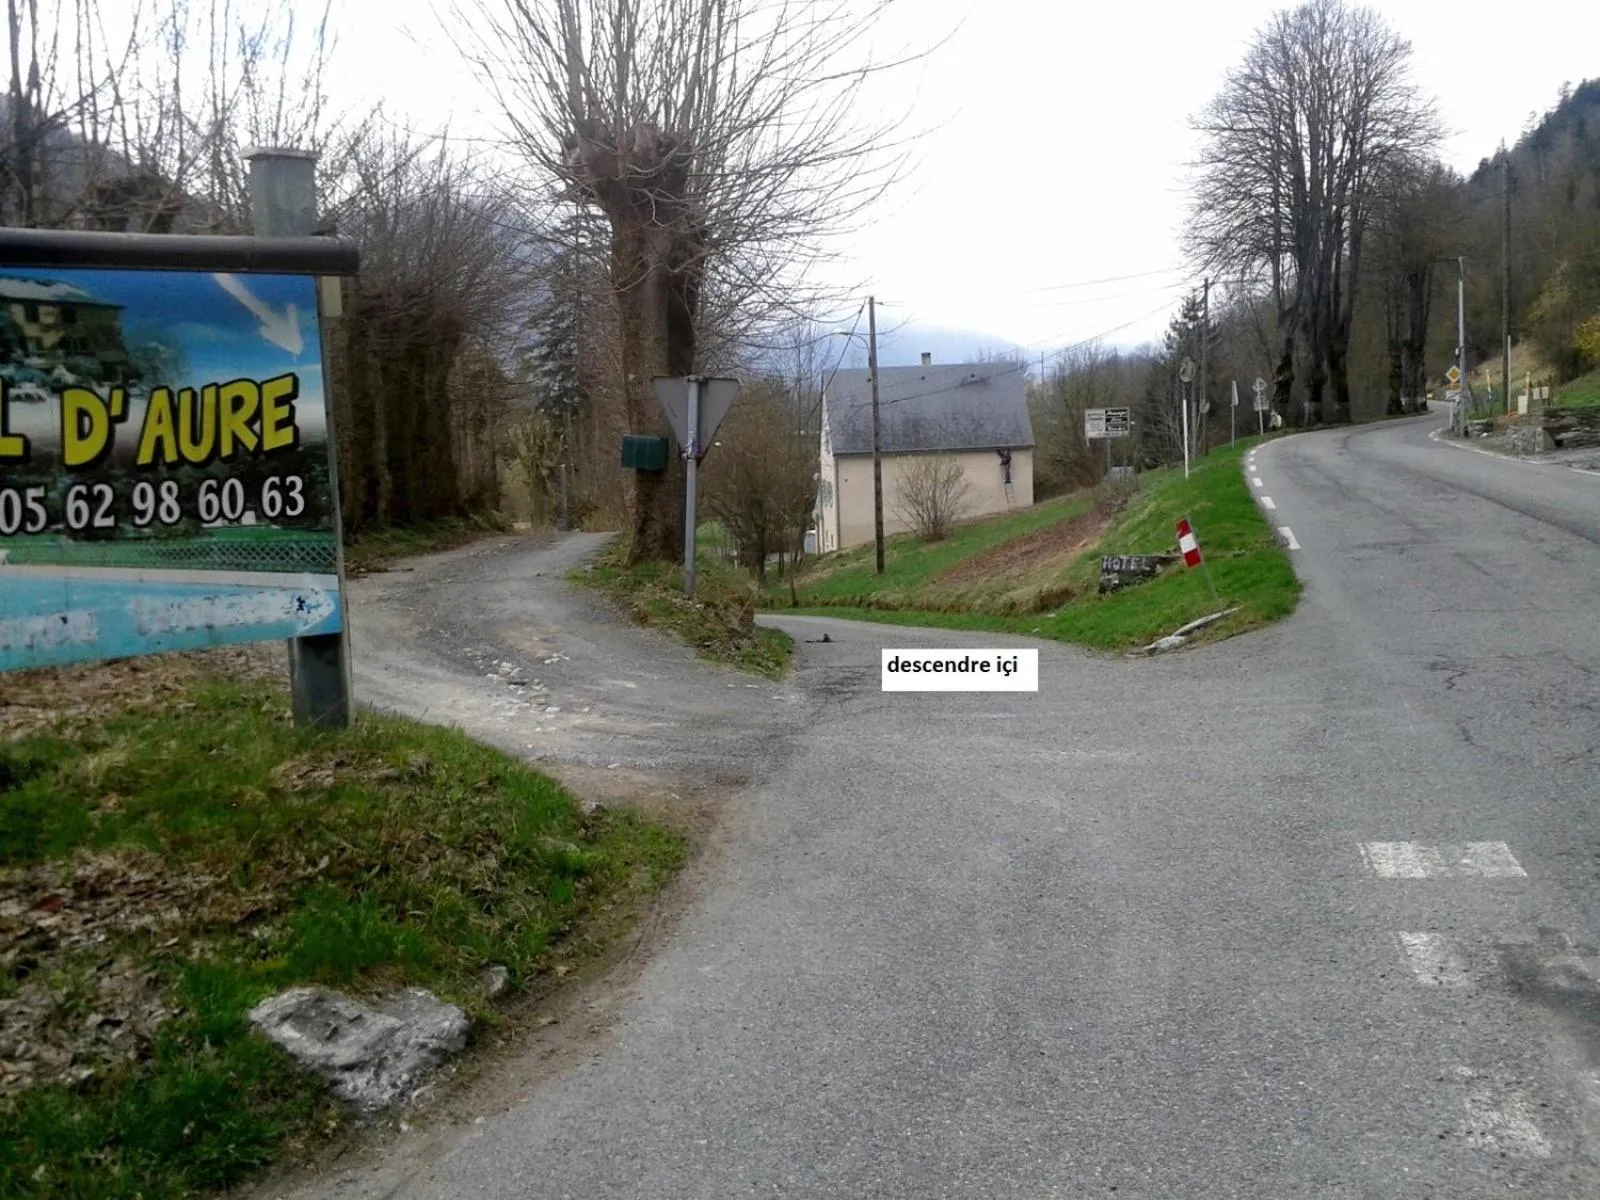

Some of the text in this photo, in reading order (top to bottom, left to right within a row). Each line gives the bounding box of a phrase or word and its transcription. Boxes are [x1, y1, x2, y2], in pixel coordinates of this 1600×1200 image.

[0, 475, 305, 534] 05 62 98 60 63
[1102, 555, 1152, 571] HOTEL
